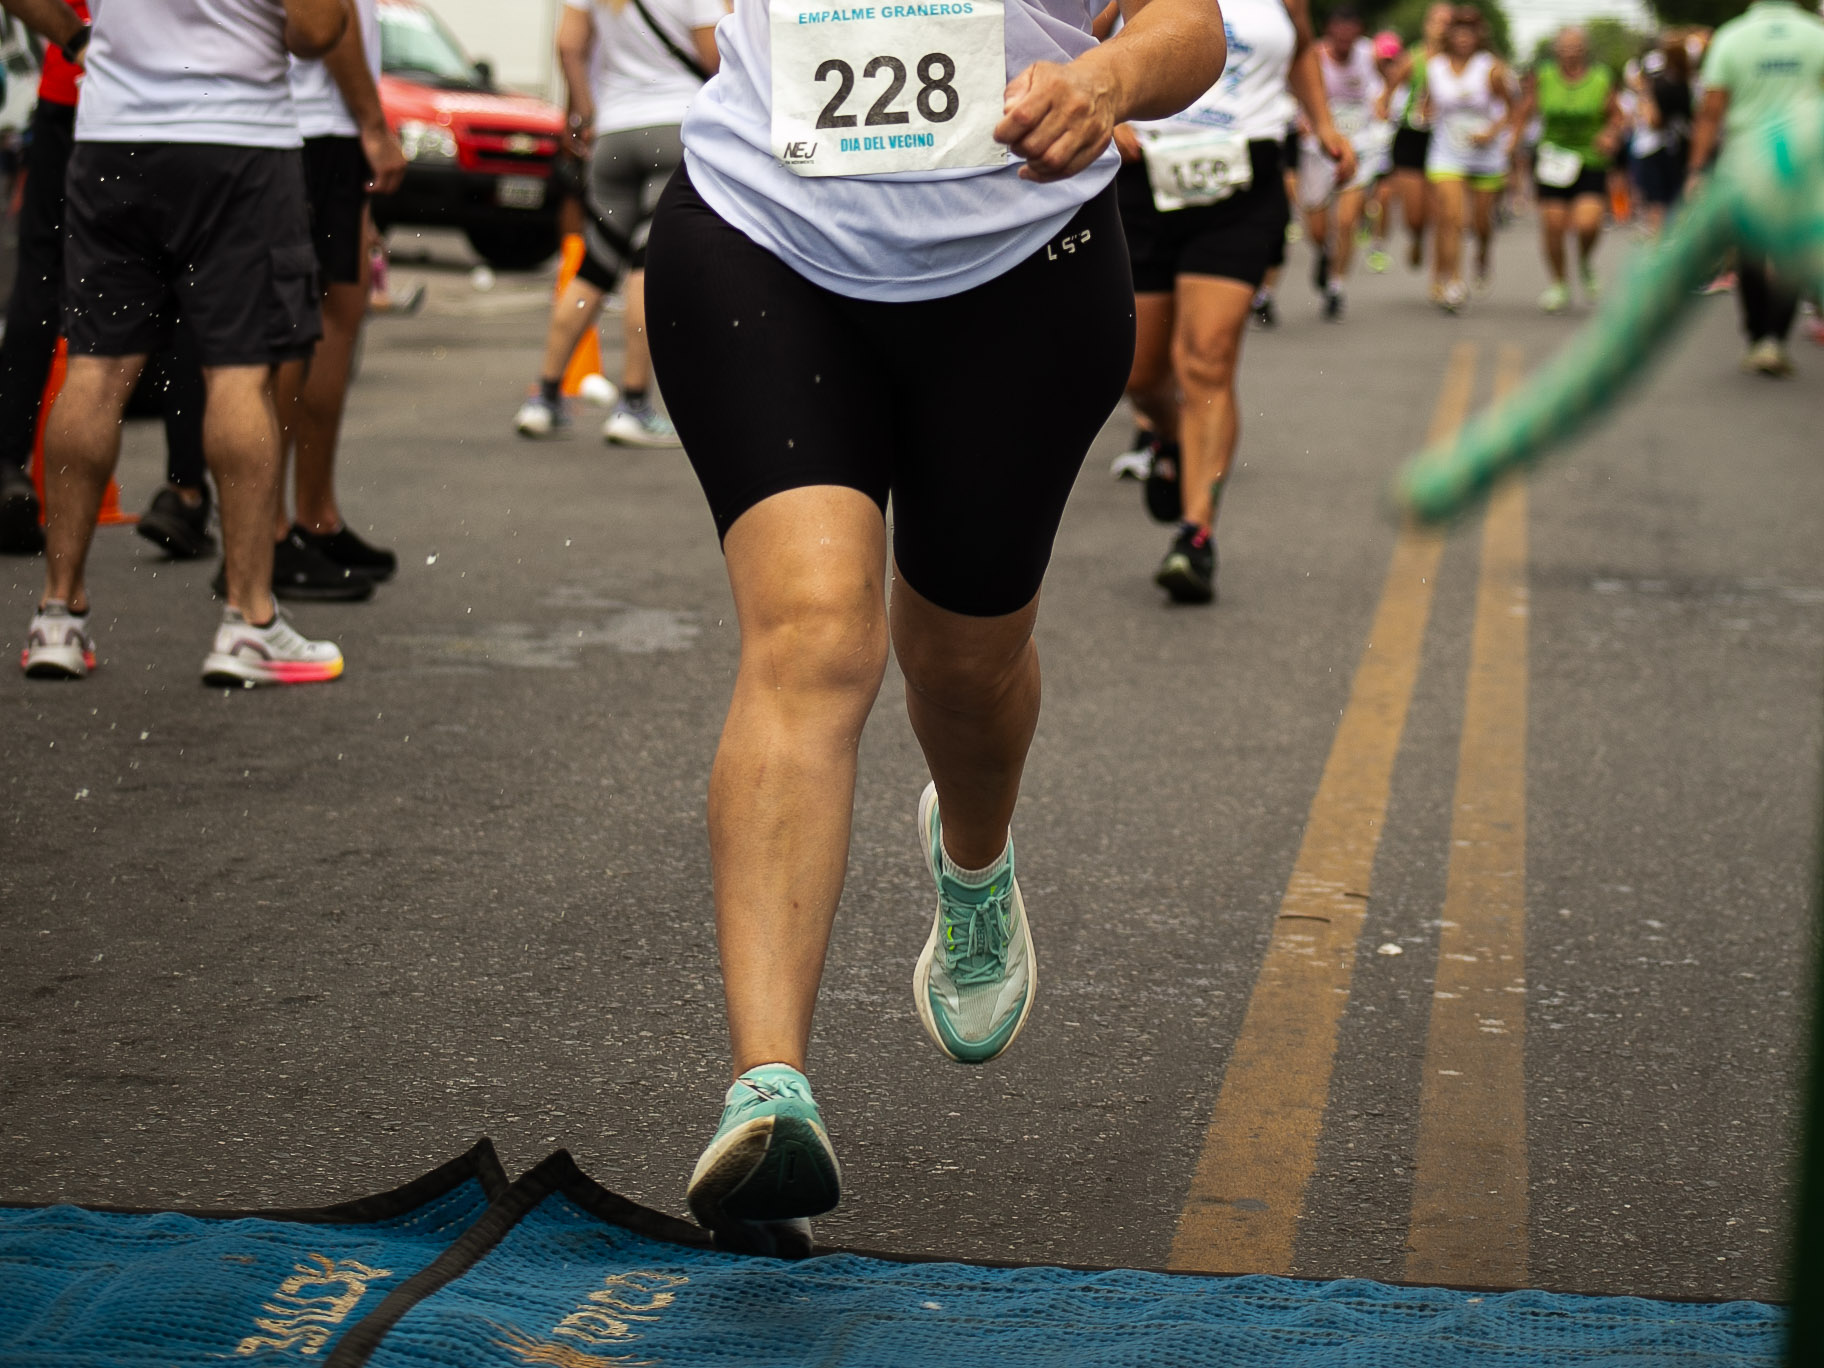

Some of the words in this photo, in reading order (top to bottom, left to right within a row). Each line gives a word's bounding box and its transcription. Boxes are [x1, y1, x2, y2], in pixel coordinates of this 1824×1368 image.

[798, 7, 876, 24] EMPALME
[881, 2, 974, 18] GRANEROS
[814, 52, 960, 130] 228
[783, 142, 818, 159] NEJ
[840, 137, 859, 153] DIA
[863, 136, 885, 151] DEL
[888, 132, 935, 149] VECINO
